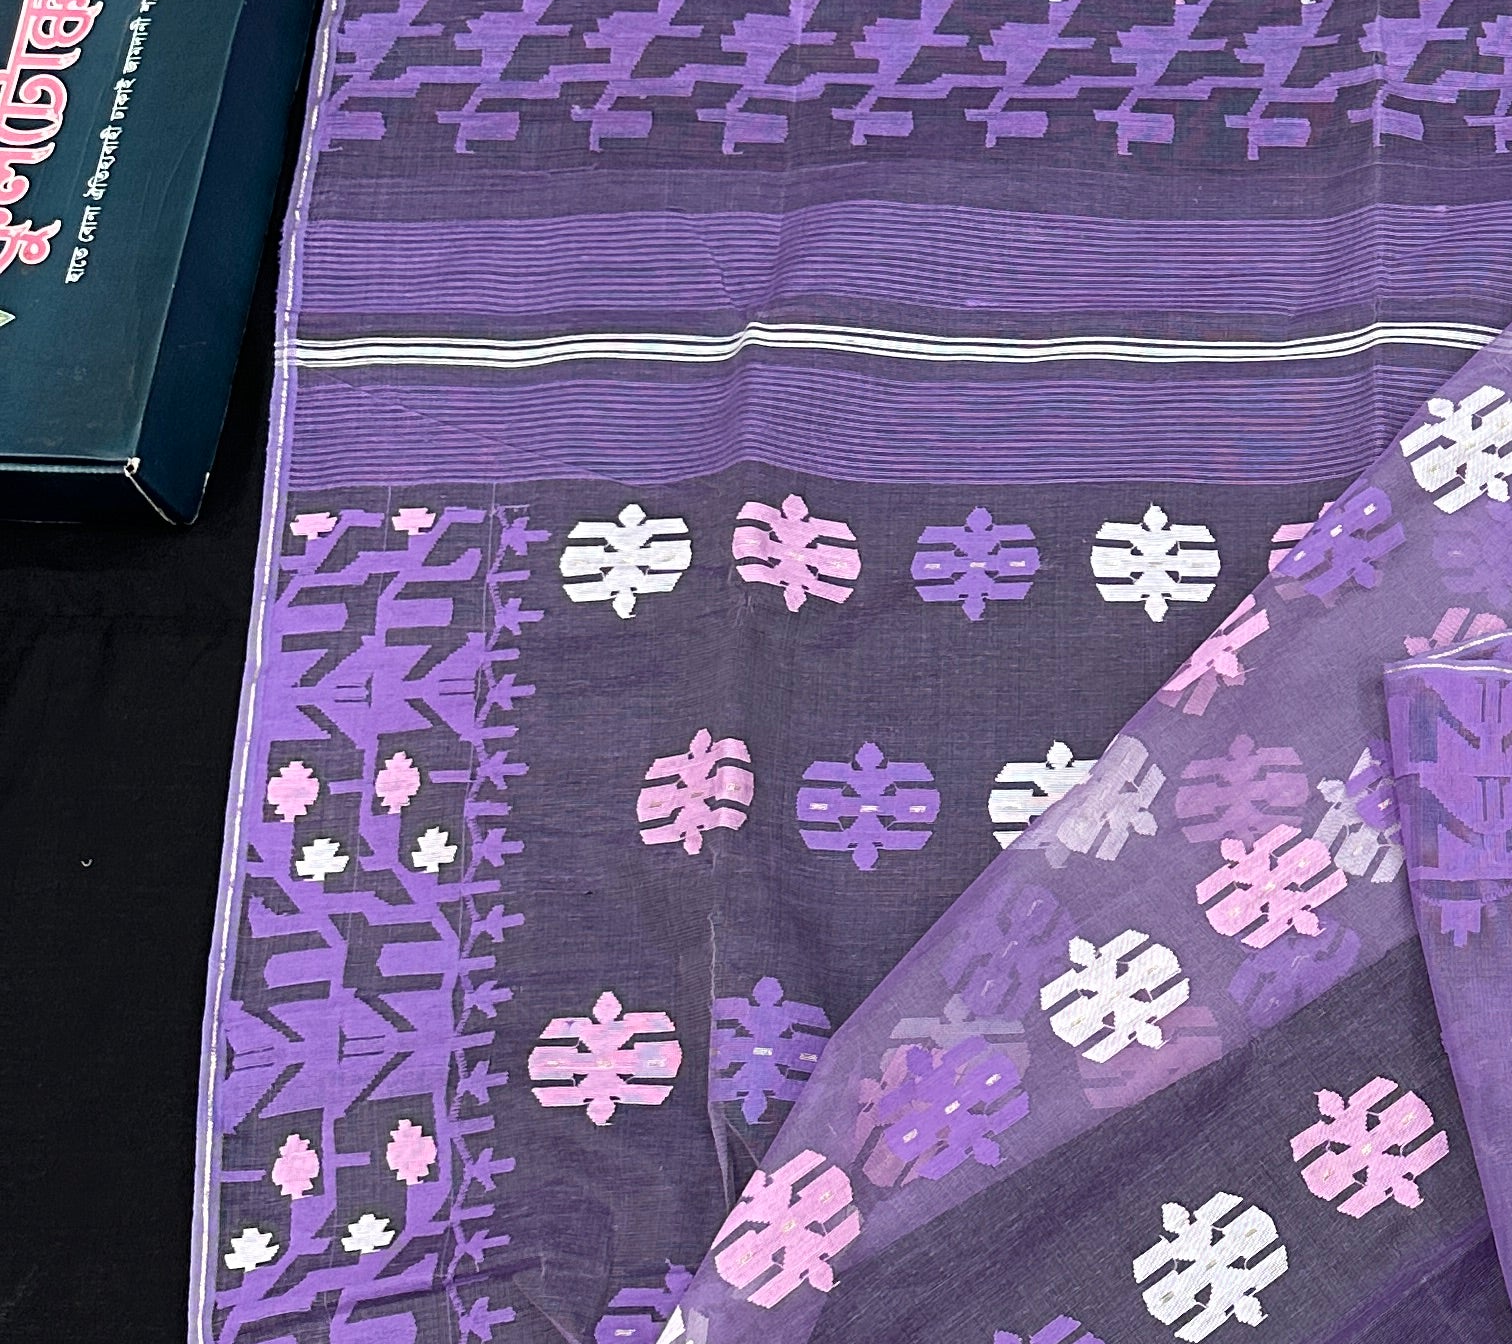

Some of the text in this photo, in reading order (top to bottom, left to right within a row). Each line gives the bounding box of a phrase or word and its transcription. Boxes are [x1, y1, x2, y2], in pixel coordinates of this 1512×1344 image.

[123, 16, 152, 75] জামদানী
[111, 78, 136, 121] ঢাকাই
[83, 125, 123, 201] ঐতিহ্যবাহী
[78, 205, 102, 243] বোনা
[65, 246, 89, 284] হাতে
